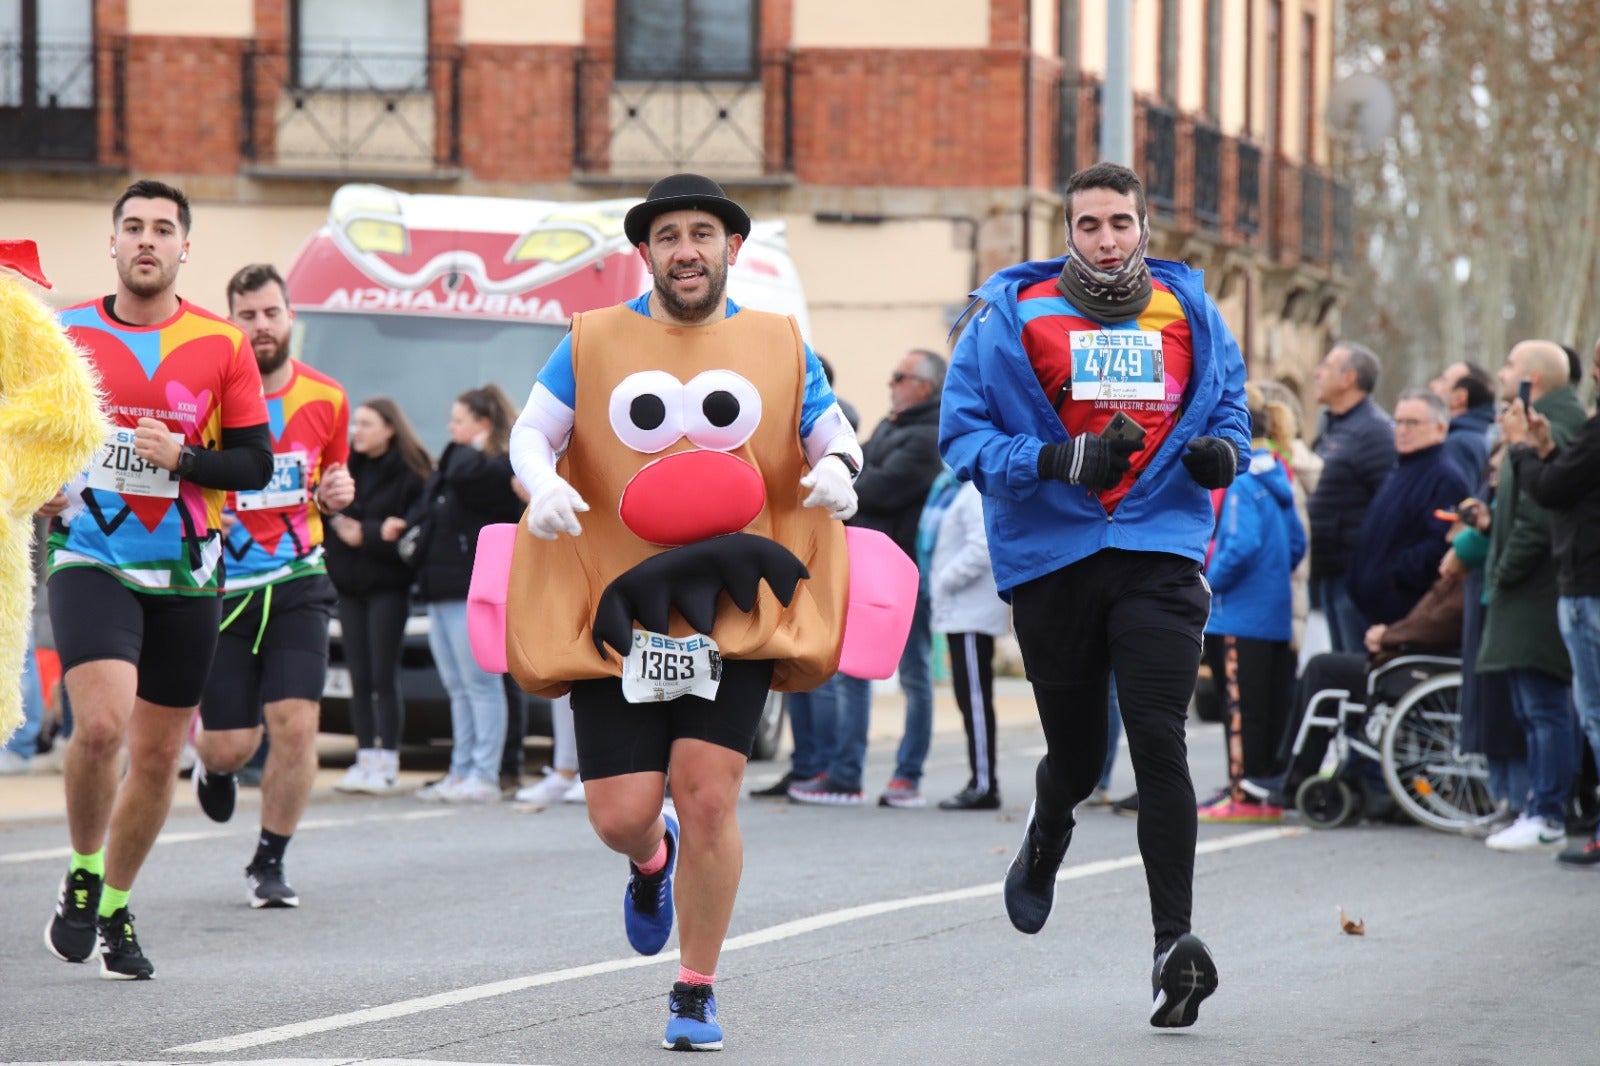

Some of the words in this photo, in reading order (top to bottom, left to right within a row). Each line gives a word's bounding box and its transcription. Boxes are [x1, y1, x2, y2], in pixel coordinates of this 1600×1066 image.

[1095, 334, 1153, 347] SETEL
[1084, 349, 1142, 377] 4749
[177, 401, 198, 413] XXXIX
[1095, 401, 1110, 409] SAN
[119, 405, 155, 418] SILVESTRE
[155, 408, 197, 423] SALMANTINA
[651, 636, 710, 652] SETEL
[641, 651, 694, 681] 1363
